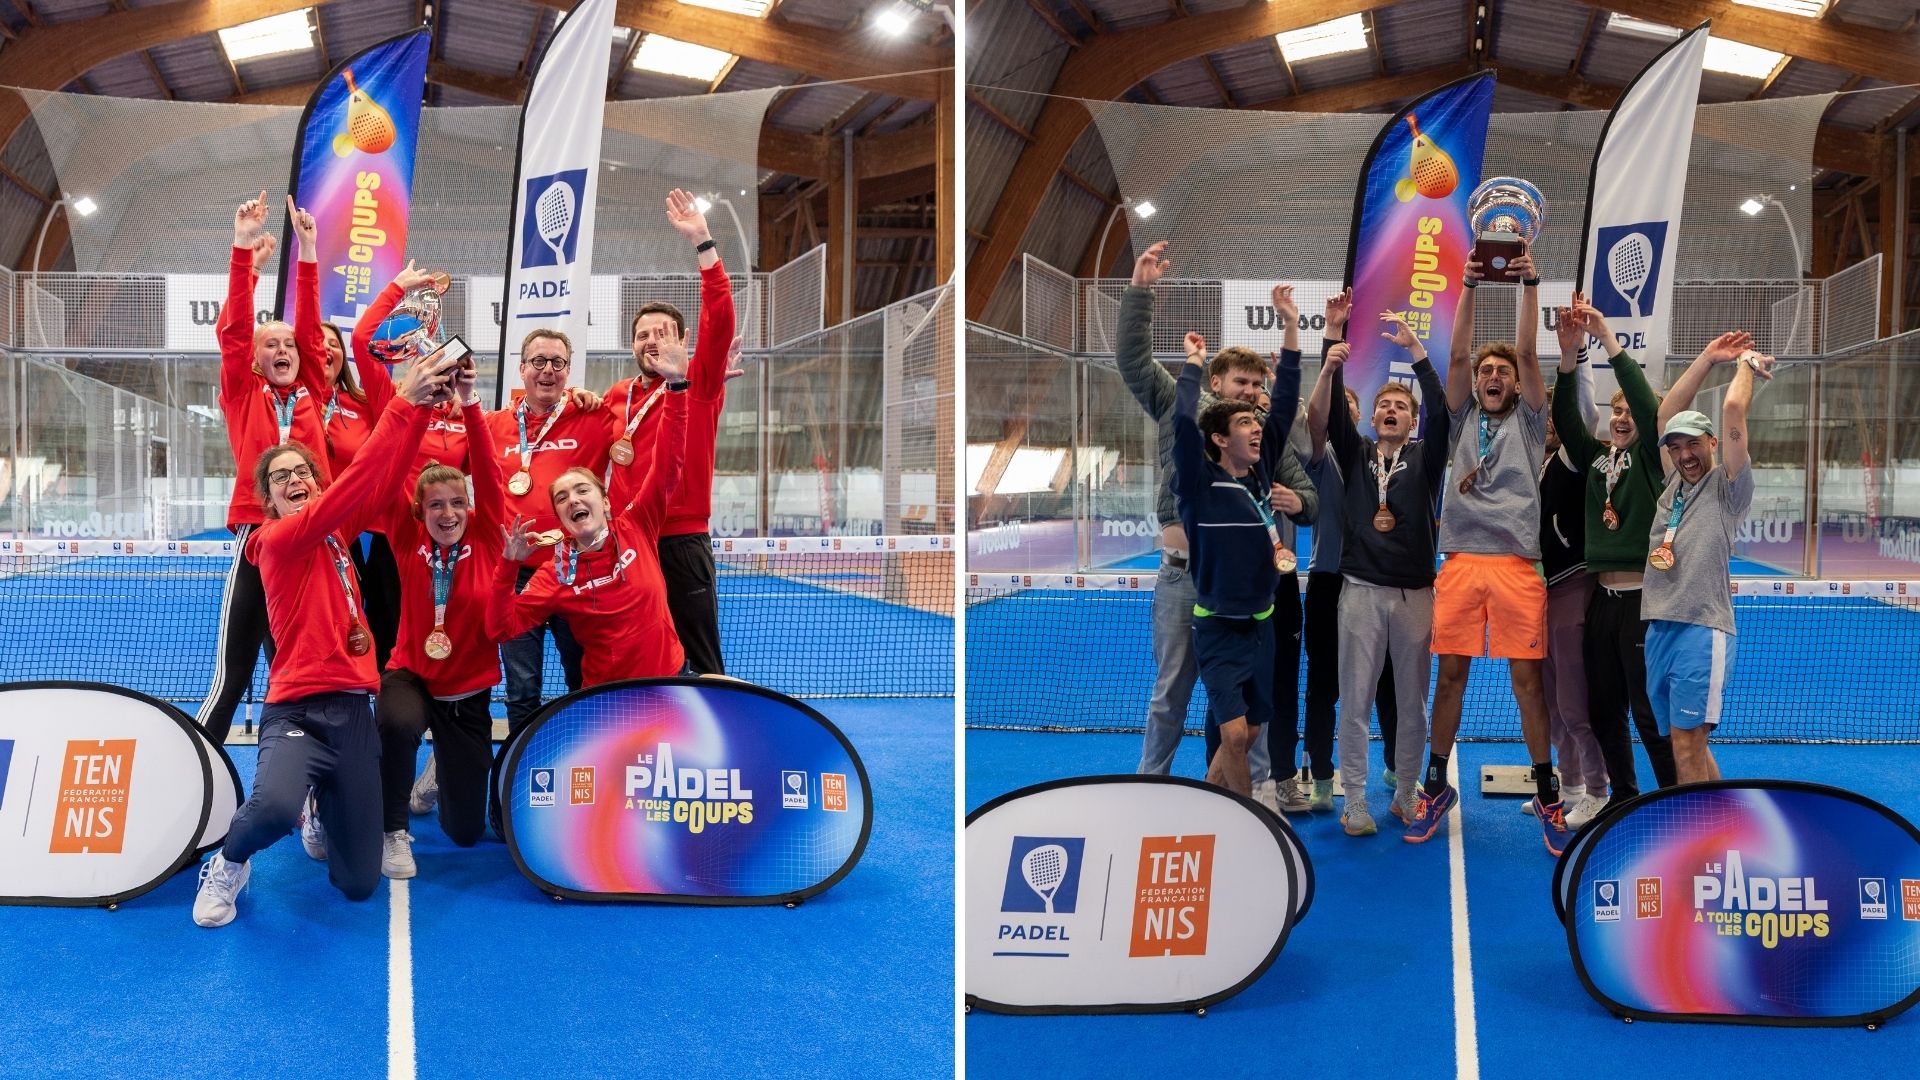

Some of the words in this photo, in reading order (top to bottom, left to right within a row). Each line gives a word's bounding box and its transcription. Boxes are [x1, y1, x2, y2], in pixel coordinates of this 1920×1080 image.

[349, 171, 387, 263] COUPS
[1409, 216, 1448, 309] COUPS
[345, 265, 359, 303] TOUS
[357, 266, 372, 294] LES
[520, 279, 570, 300] PADEL
[1245, 305, 1326, 330] Wiso
[1419, 312, 1432, 340] LES
[1588, 331, 1646, 350] PDEL
[504, 438, 578, 457] HEAD
[573, 548, 637, 595] HEAD
[637, 753, 653, 764] LE
[73, 754, 122, 785] TEN
[574, 771, 591, 783] TEN
[625, 742, 753, 799] PADEL
[574, 788, 590, 799] NIS
[825, 778, 842, 790] TEN
[637, 799, 671, 811] TOUS
[827, 794, 843, 806] NIS
[63, 807, 114, 838] NIS
[646, 811, 671, 822] LES
[673, 800, 754, 834] COUPS
[1149, 850, 1201, 884] TEN
[1705, 862, 1722, 873] LE
[1639, 883, 1657, 895] TEN
[1693, 849, 1829, 911] PADEL
[1140, 895, 1205, 903] FRANÇAISE
[1641, 900, 1657, 912] NIS
[1143, 906, 1195, 941] NIS
[1707, 911, 1742, 924] TOUS
[998, 924, 1070, 941] PADEL
[1717, 924, 1742, 936] LES
[1745, 912, 1830, 949] COUPS
